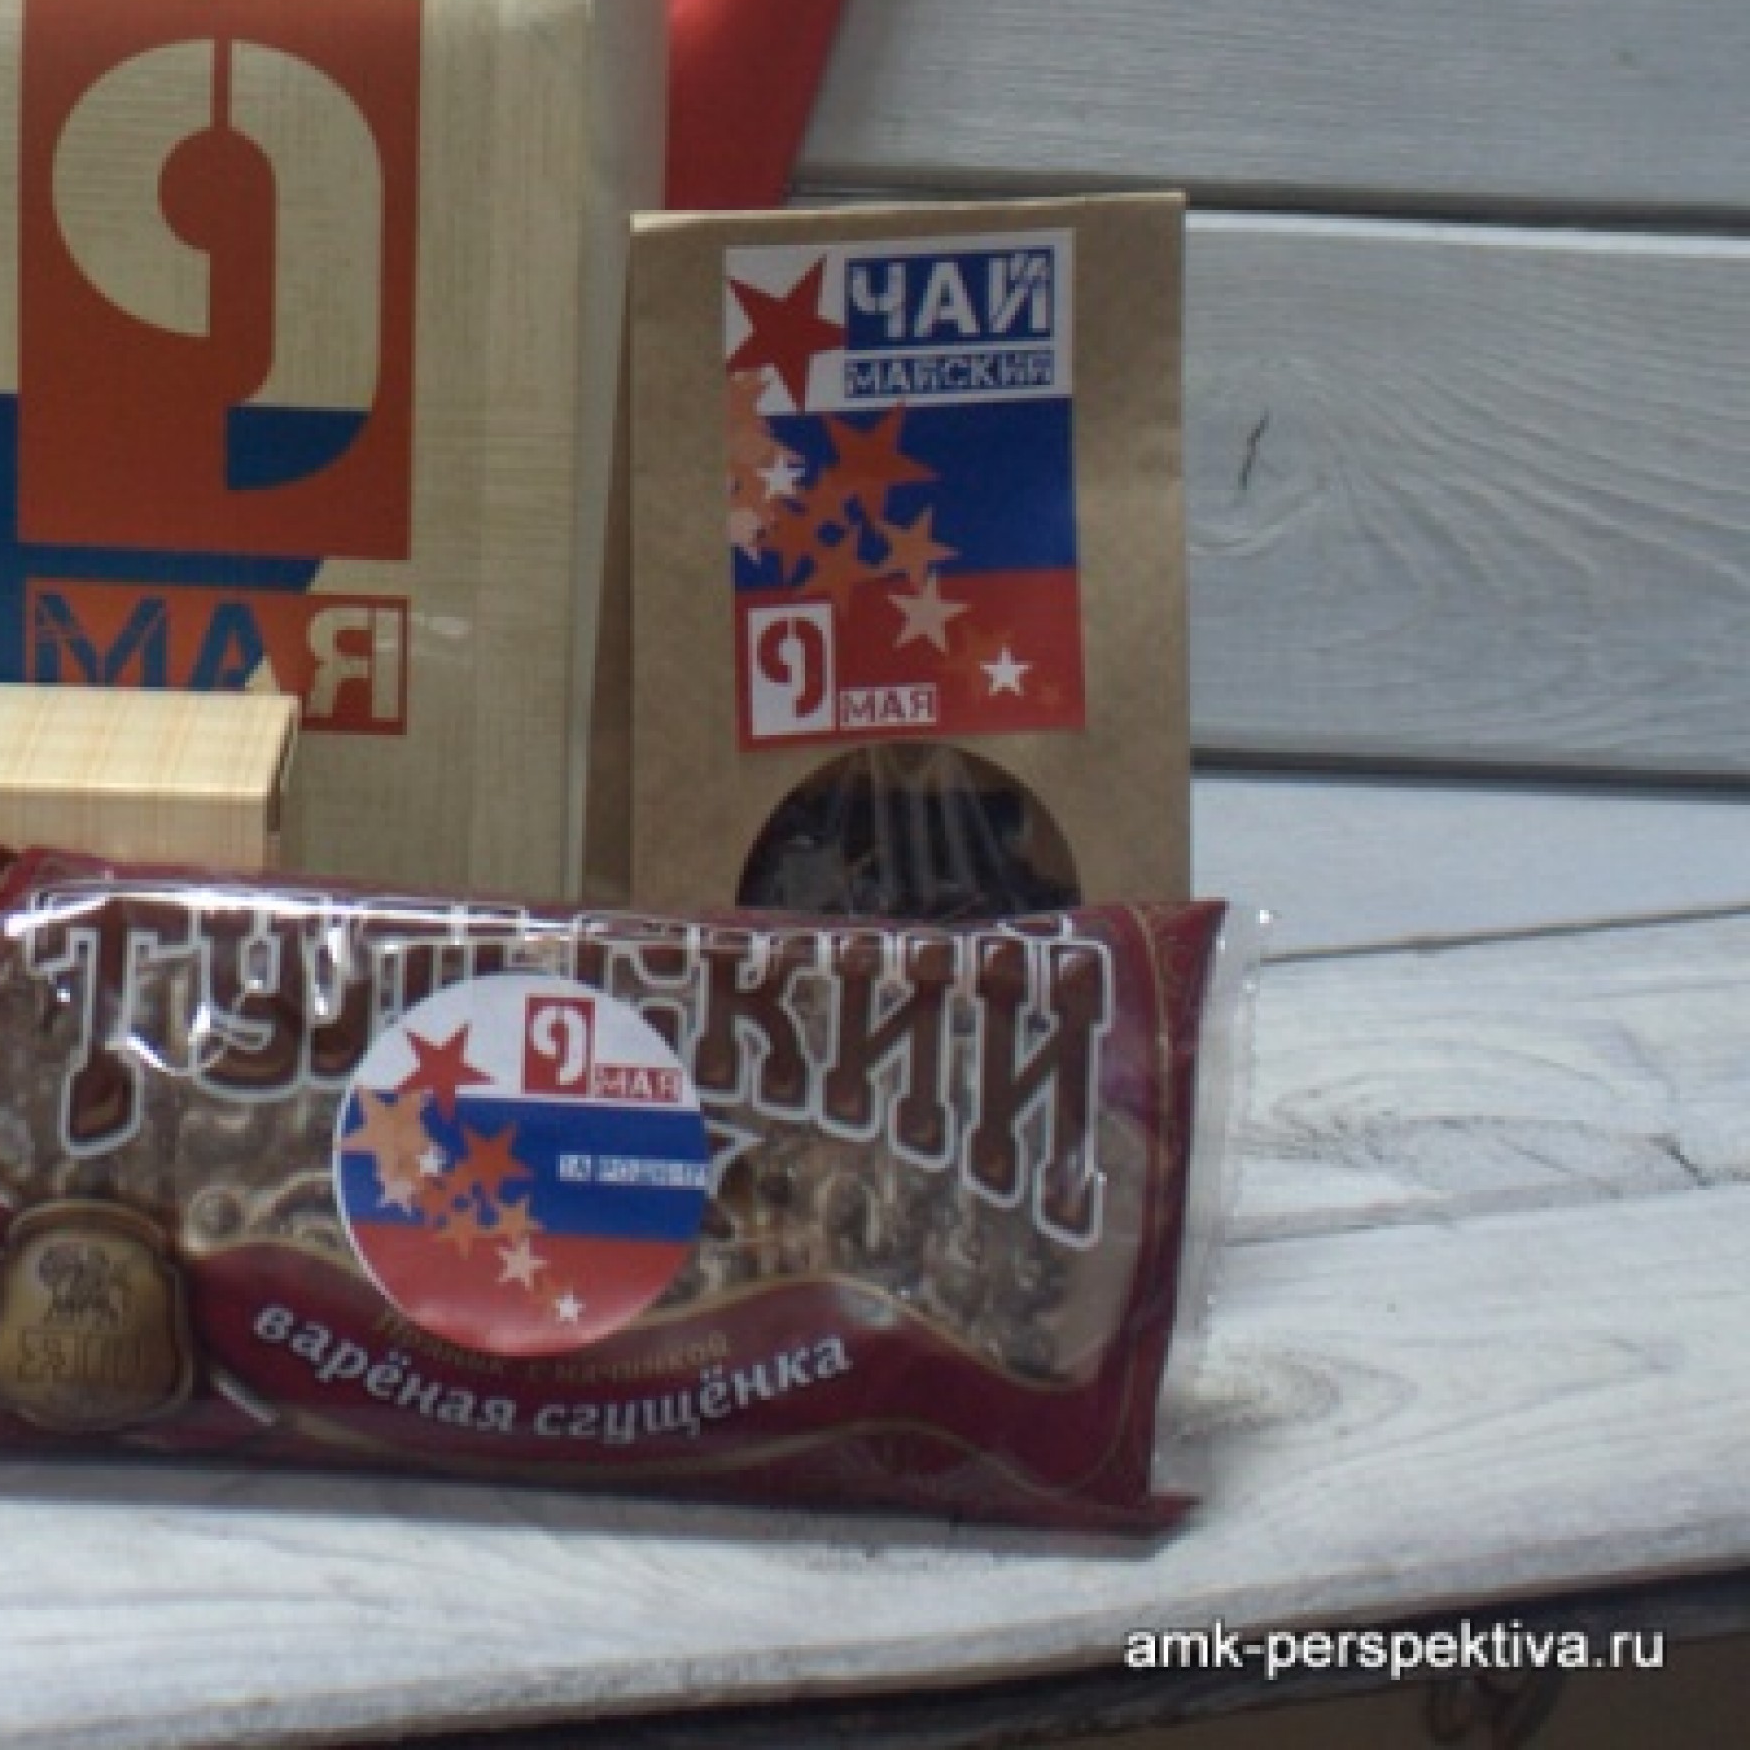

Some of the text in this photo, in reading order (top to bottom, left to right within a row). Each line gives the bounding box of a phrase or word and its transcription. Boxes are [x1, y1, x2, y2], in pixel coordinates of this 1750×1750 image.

[51, 37, 386, 491] 9
[851, 252, 1048, 339] ЧАЙ
[34, 592, 404, 725] МАЯ
[756, 614, 935, 725] 9 МАЯ
[532, 1005, 587, 1086] 9
[252, 1303, 518, 1435] варёная
[531, 1333, 854, 1445] сгущёнка
